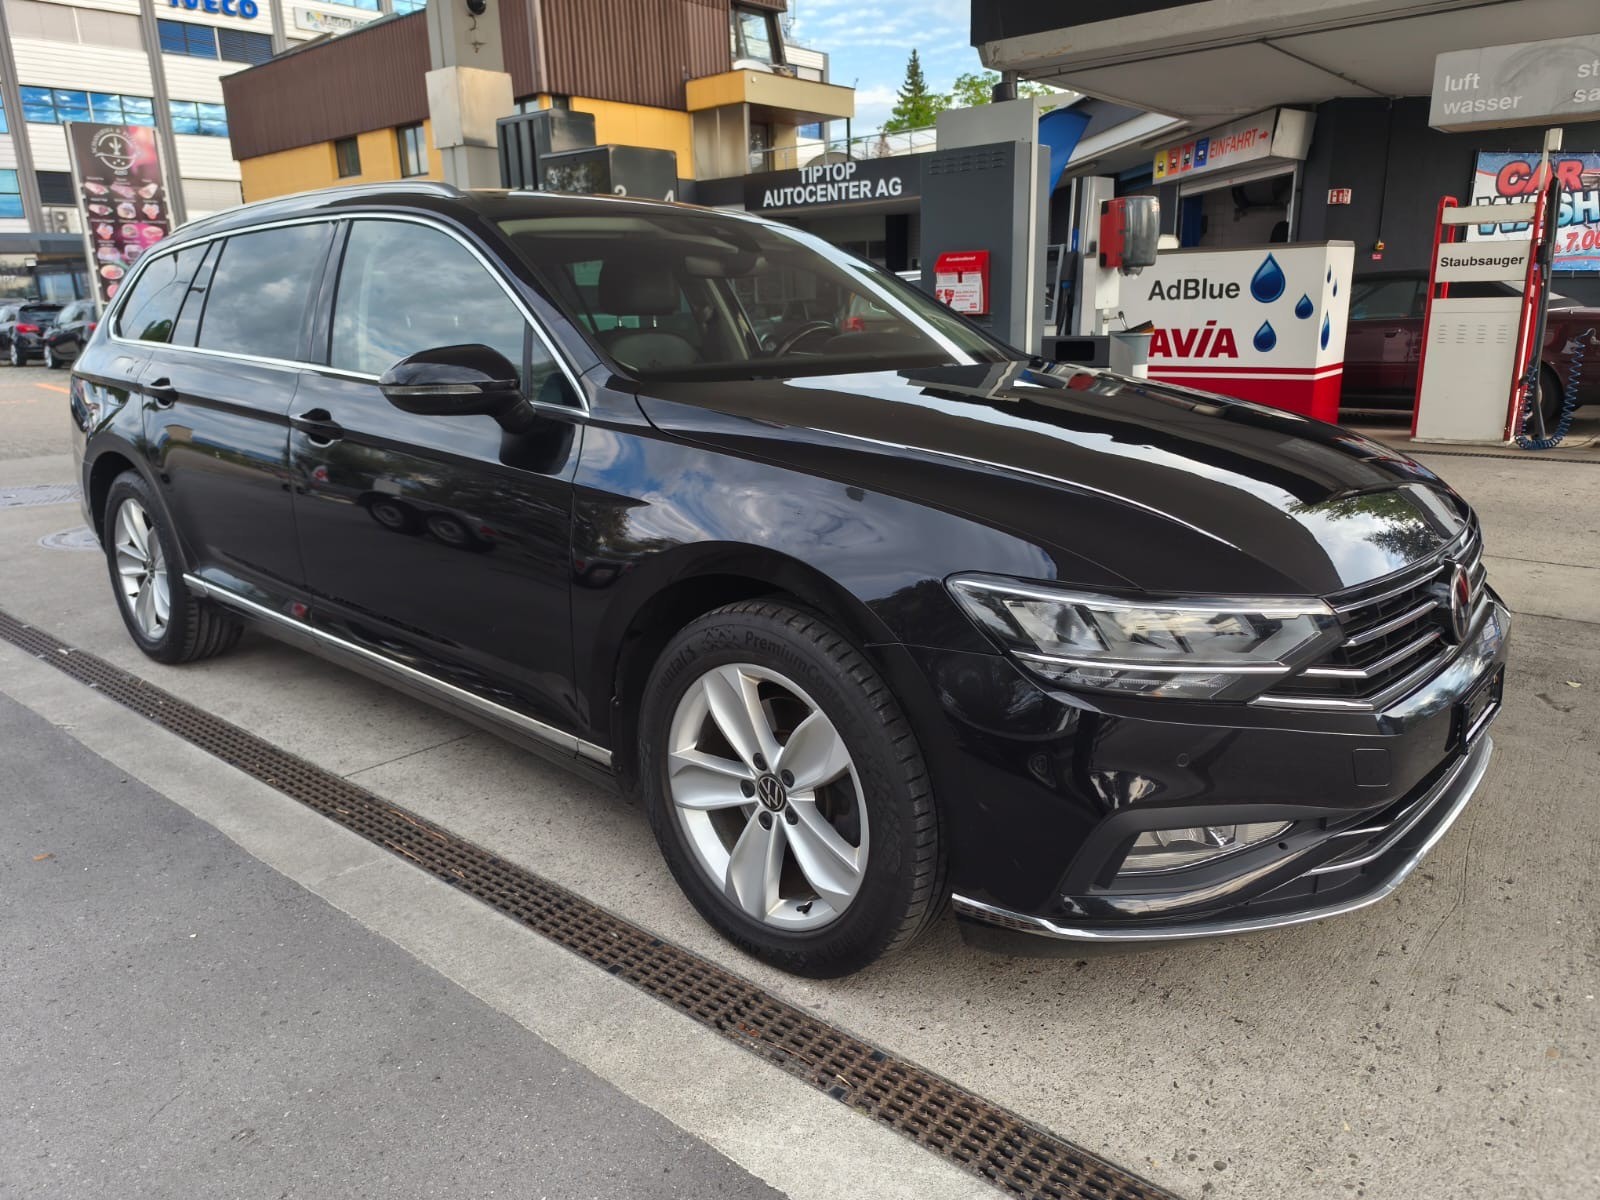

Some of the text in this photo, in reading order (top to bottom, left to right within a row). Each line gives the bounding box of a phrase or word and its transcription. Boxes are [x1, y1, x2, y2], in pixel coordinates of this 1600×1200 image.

[1444, 73, 1480, 92] luft
[1443, 96, 1523, 115] wasser
[1209, 128, 1259, 159] EINFAHRT
[799, 162, 857, 184] TIPTOP
[1496, 160, 1584, 196] CAR
[762, 176, 902, 208] AUTOCENTER AG
[1440, 256, 1525, 268] Staubsauger
[1148, 278, 1240, 301] AdBlue
